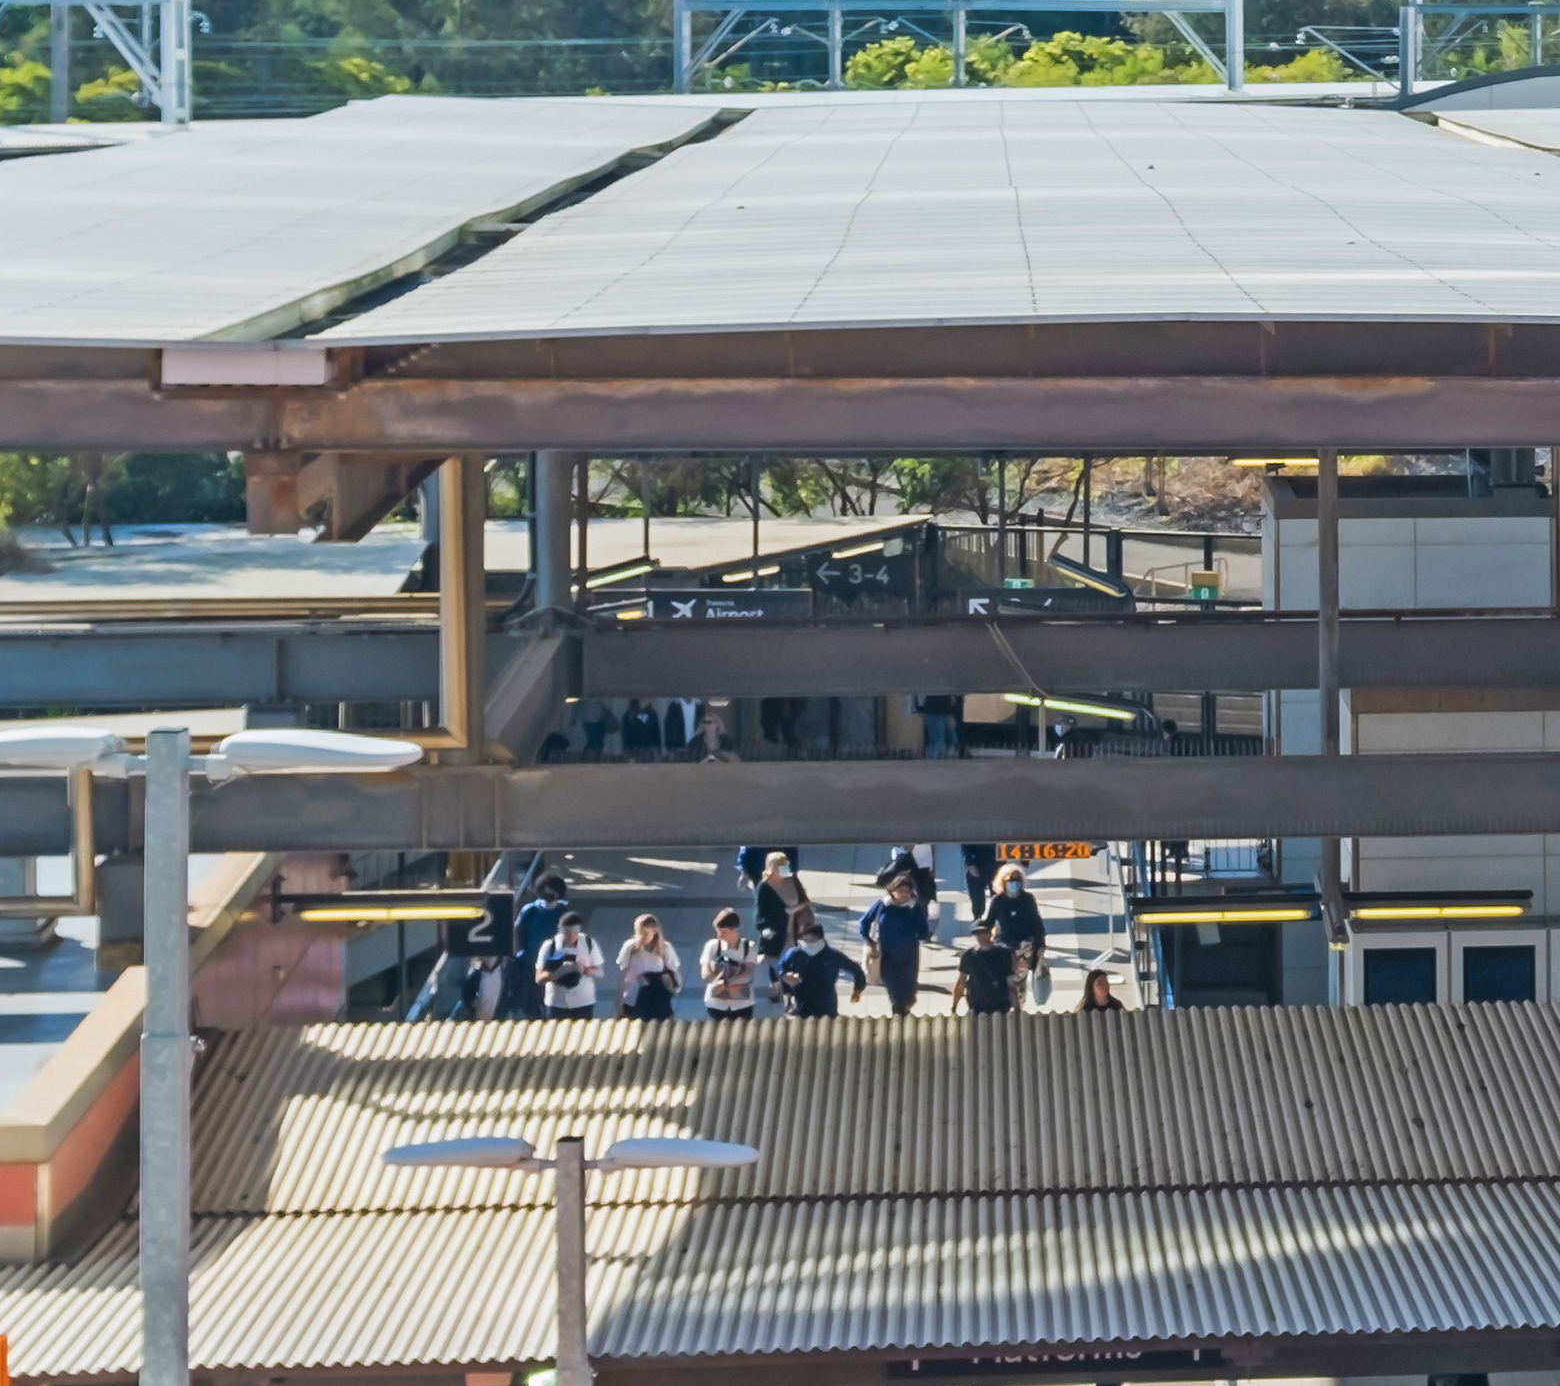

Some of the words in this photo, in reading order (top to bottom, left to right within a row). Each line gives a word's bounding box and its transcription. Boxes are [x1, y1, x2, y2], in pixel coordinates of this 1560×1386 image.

[848, 564, 891, 585] 3-4
[1000, 843, 1090, 859] 14:16:20
[467, 907, 494, 943] 2
